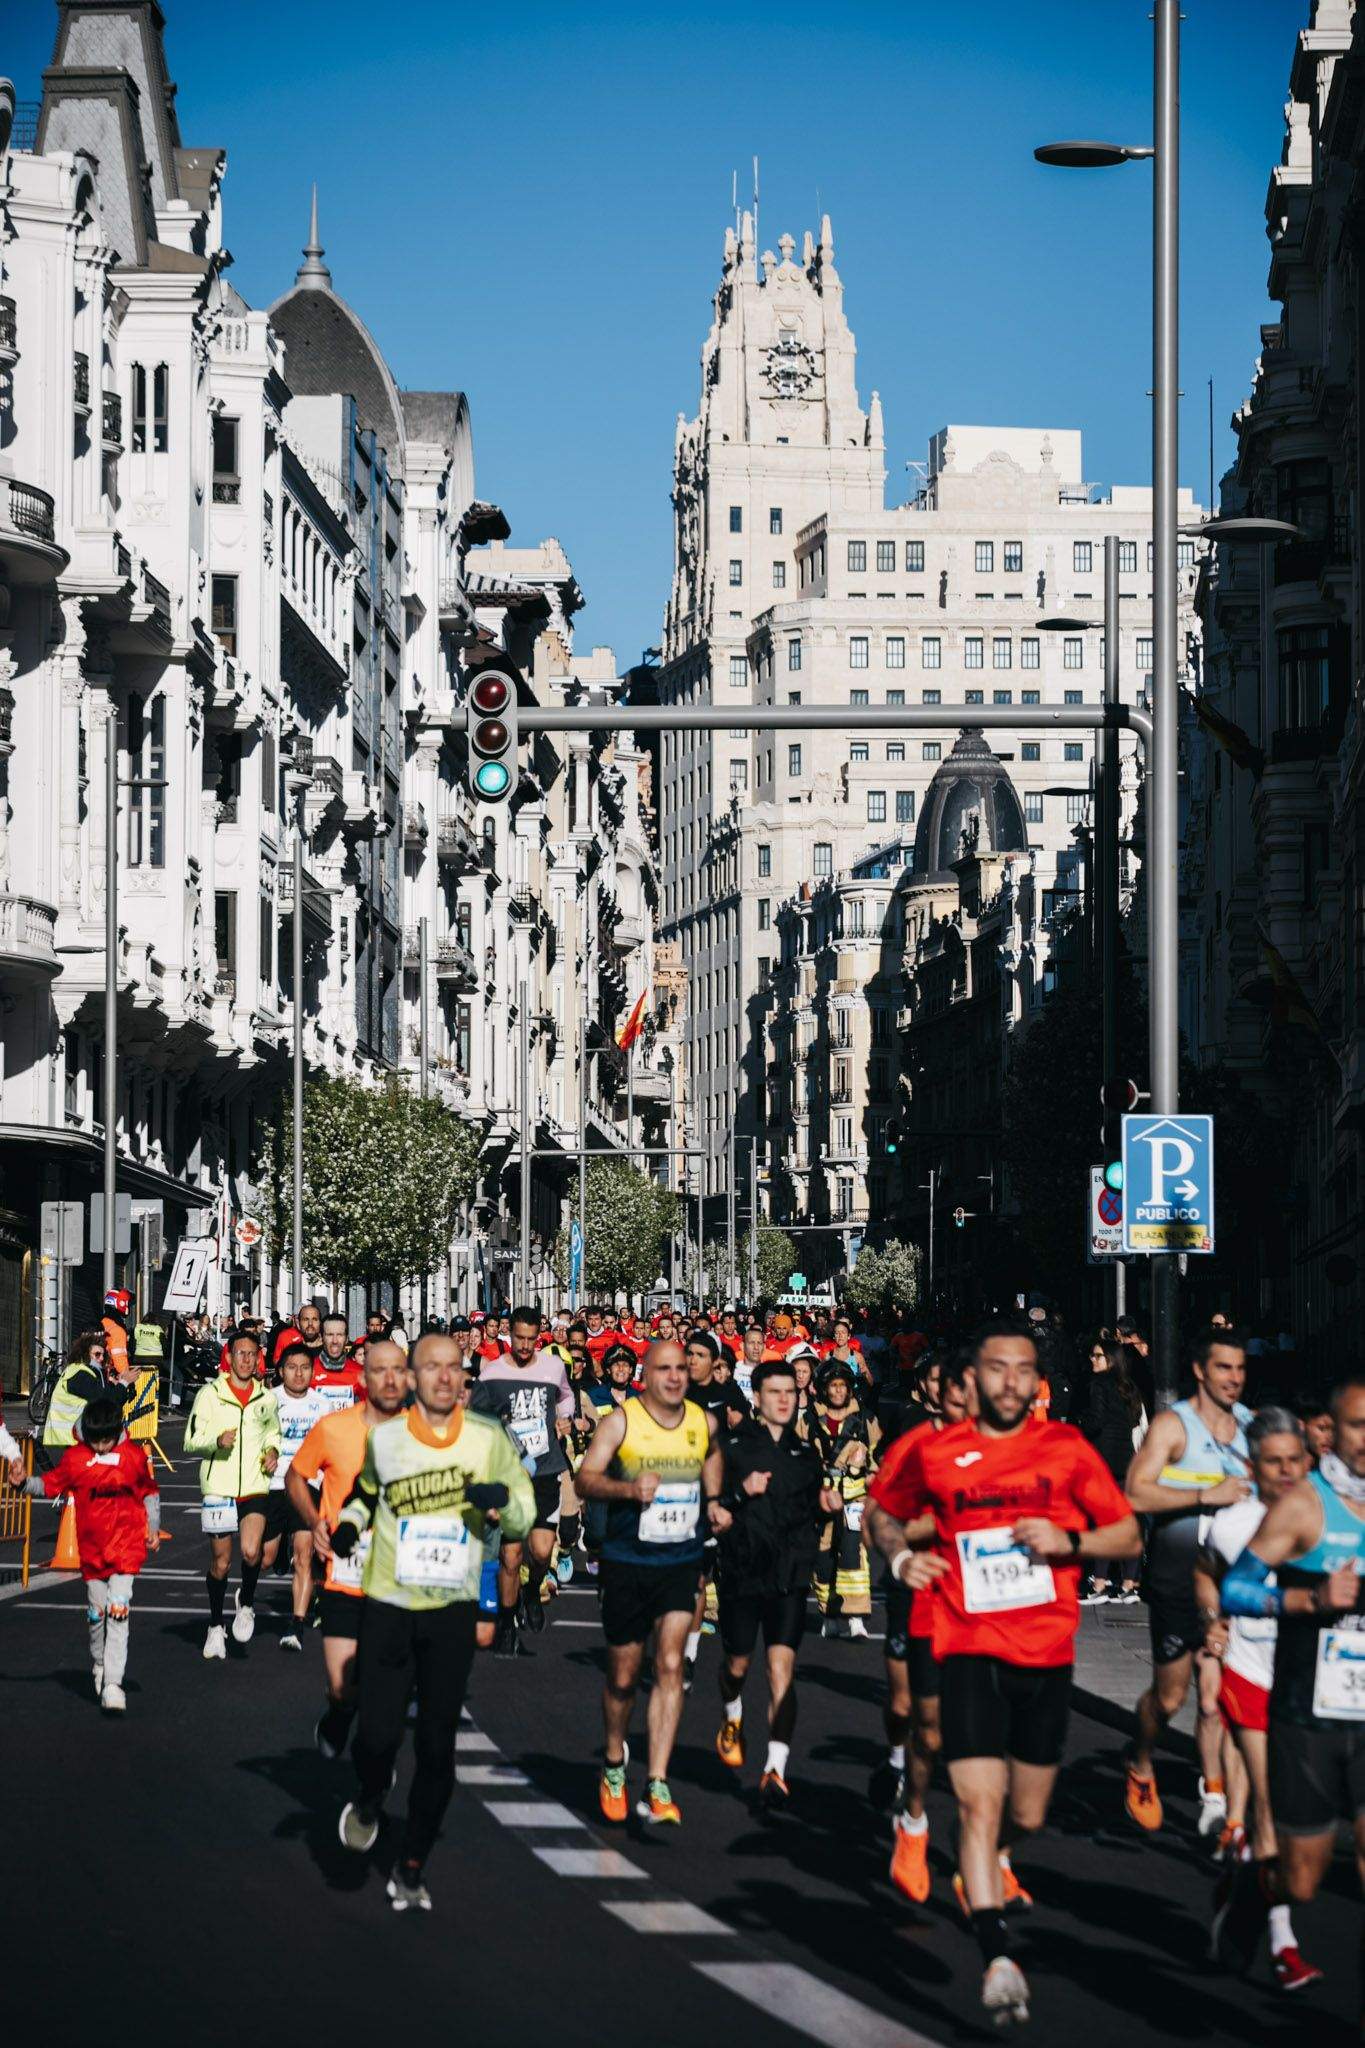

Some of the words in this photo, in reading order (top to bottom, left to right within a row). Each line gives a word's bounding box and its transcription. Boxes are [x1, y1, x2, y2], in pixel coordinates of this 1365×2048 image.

[1142, 1137, 1195, 1206] P
[1136, 1208, 1200, 1220] PUBLICO
[1134, 1231, 1163, 1239] PLAZA
[1184, 1231, 1202, 1239] REY
[186, 1258, 195, 1279] 1
[658, 1510, 687, 1523] 441
[416, 1546, 451, 1563] 442
